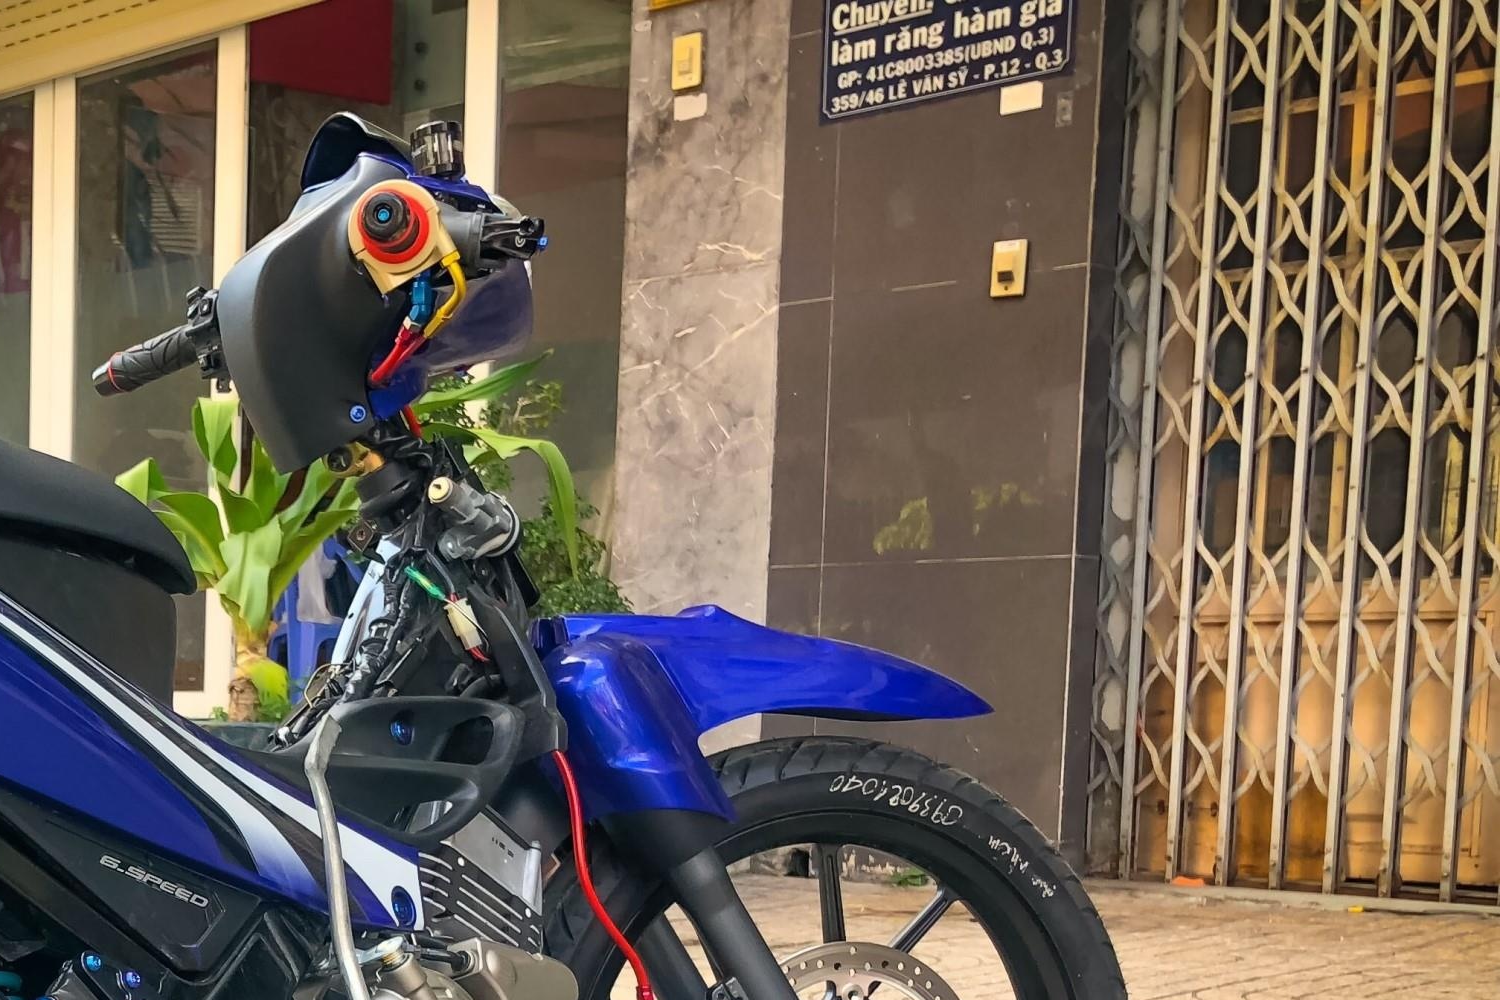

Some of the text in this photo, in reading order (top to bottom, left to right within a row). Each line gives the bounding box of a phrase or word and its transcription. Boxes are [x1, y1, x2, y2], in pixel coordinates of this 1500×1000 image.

[831, 38, 876, 66] làm
[884, 21, 945, 54] răng
[953, 6, 1011, 38] hàm
[831, 87, 885, 113] 359/46
[1034, 48, 1063, 71] Q.3
[100, 855, 209, 908] 6.SPEED
